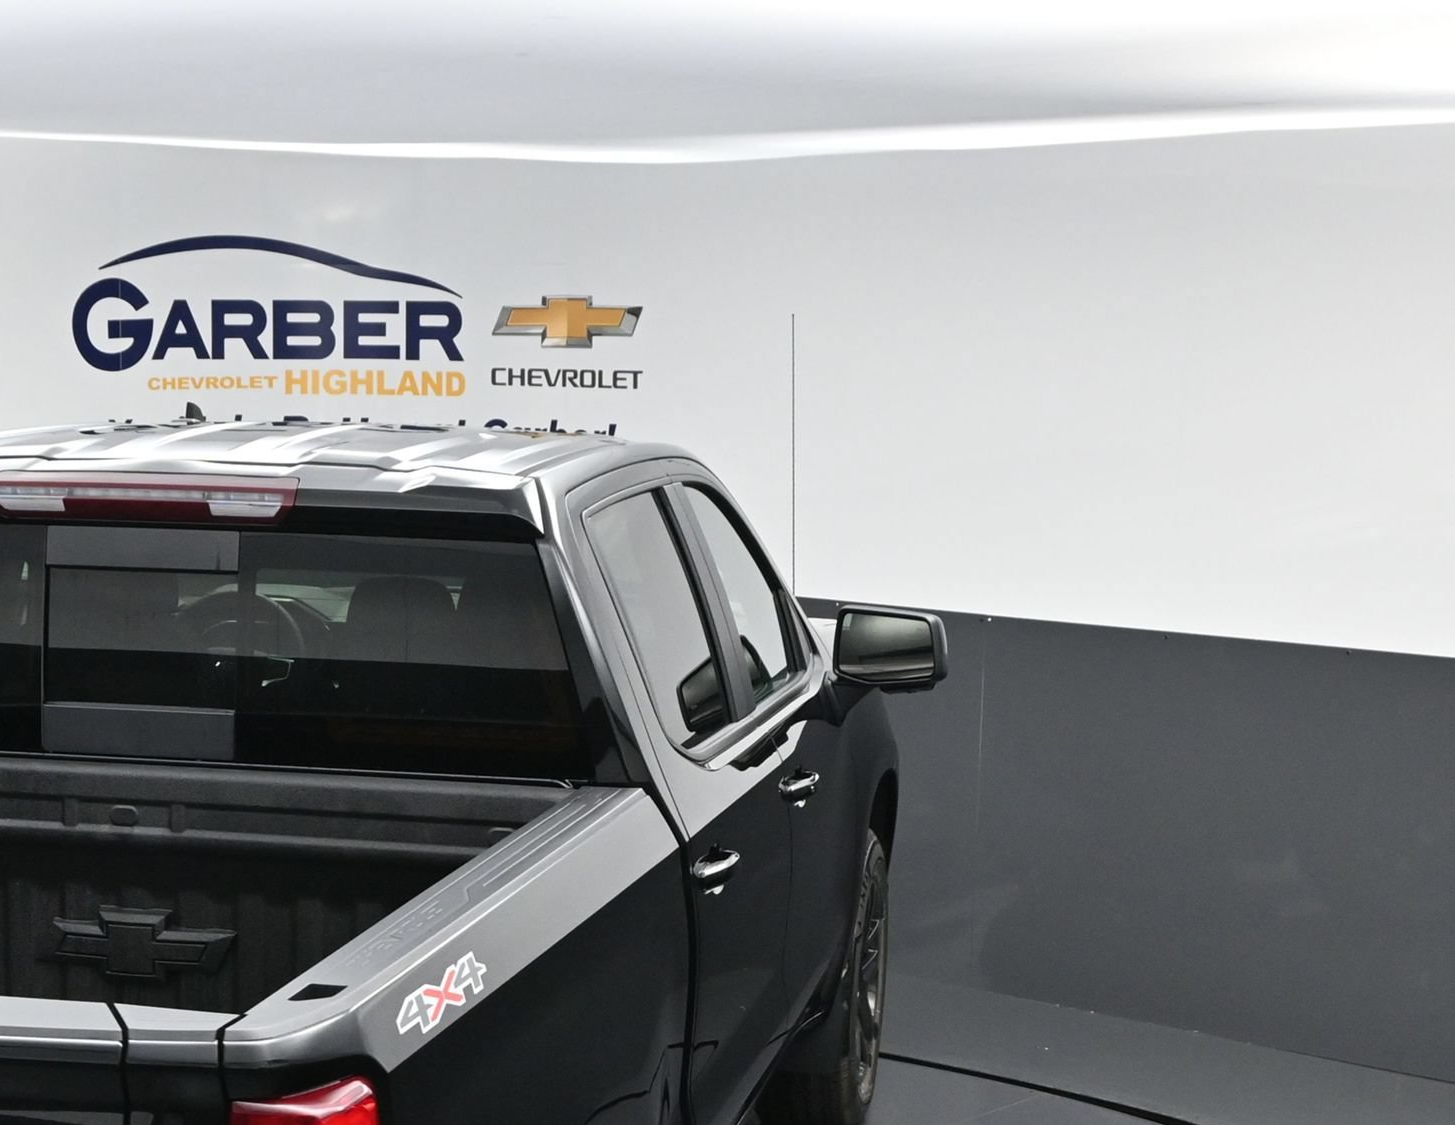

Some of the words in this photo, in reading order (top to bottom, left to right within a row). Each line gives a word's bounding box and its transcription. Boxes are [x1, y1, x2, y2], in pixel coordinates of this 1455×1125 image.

[72, 277, 464, 372] GARBER
[147, 374, 278, 391] CHEVROLET
[285, 369, 466, 397] HIGHLAND
[491, 367, 643, 390] CHEVROLET
